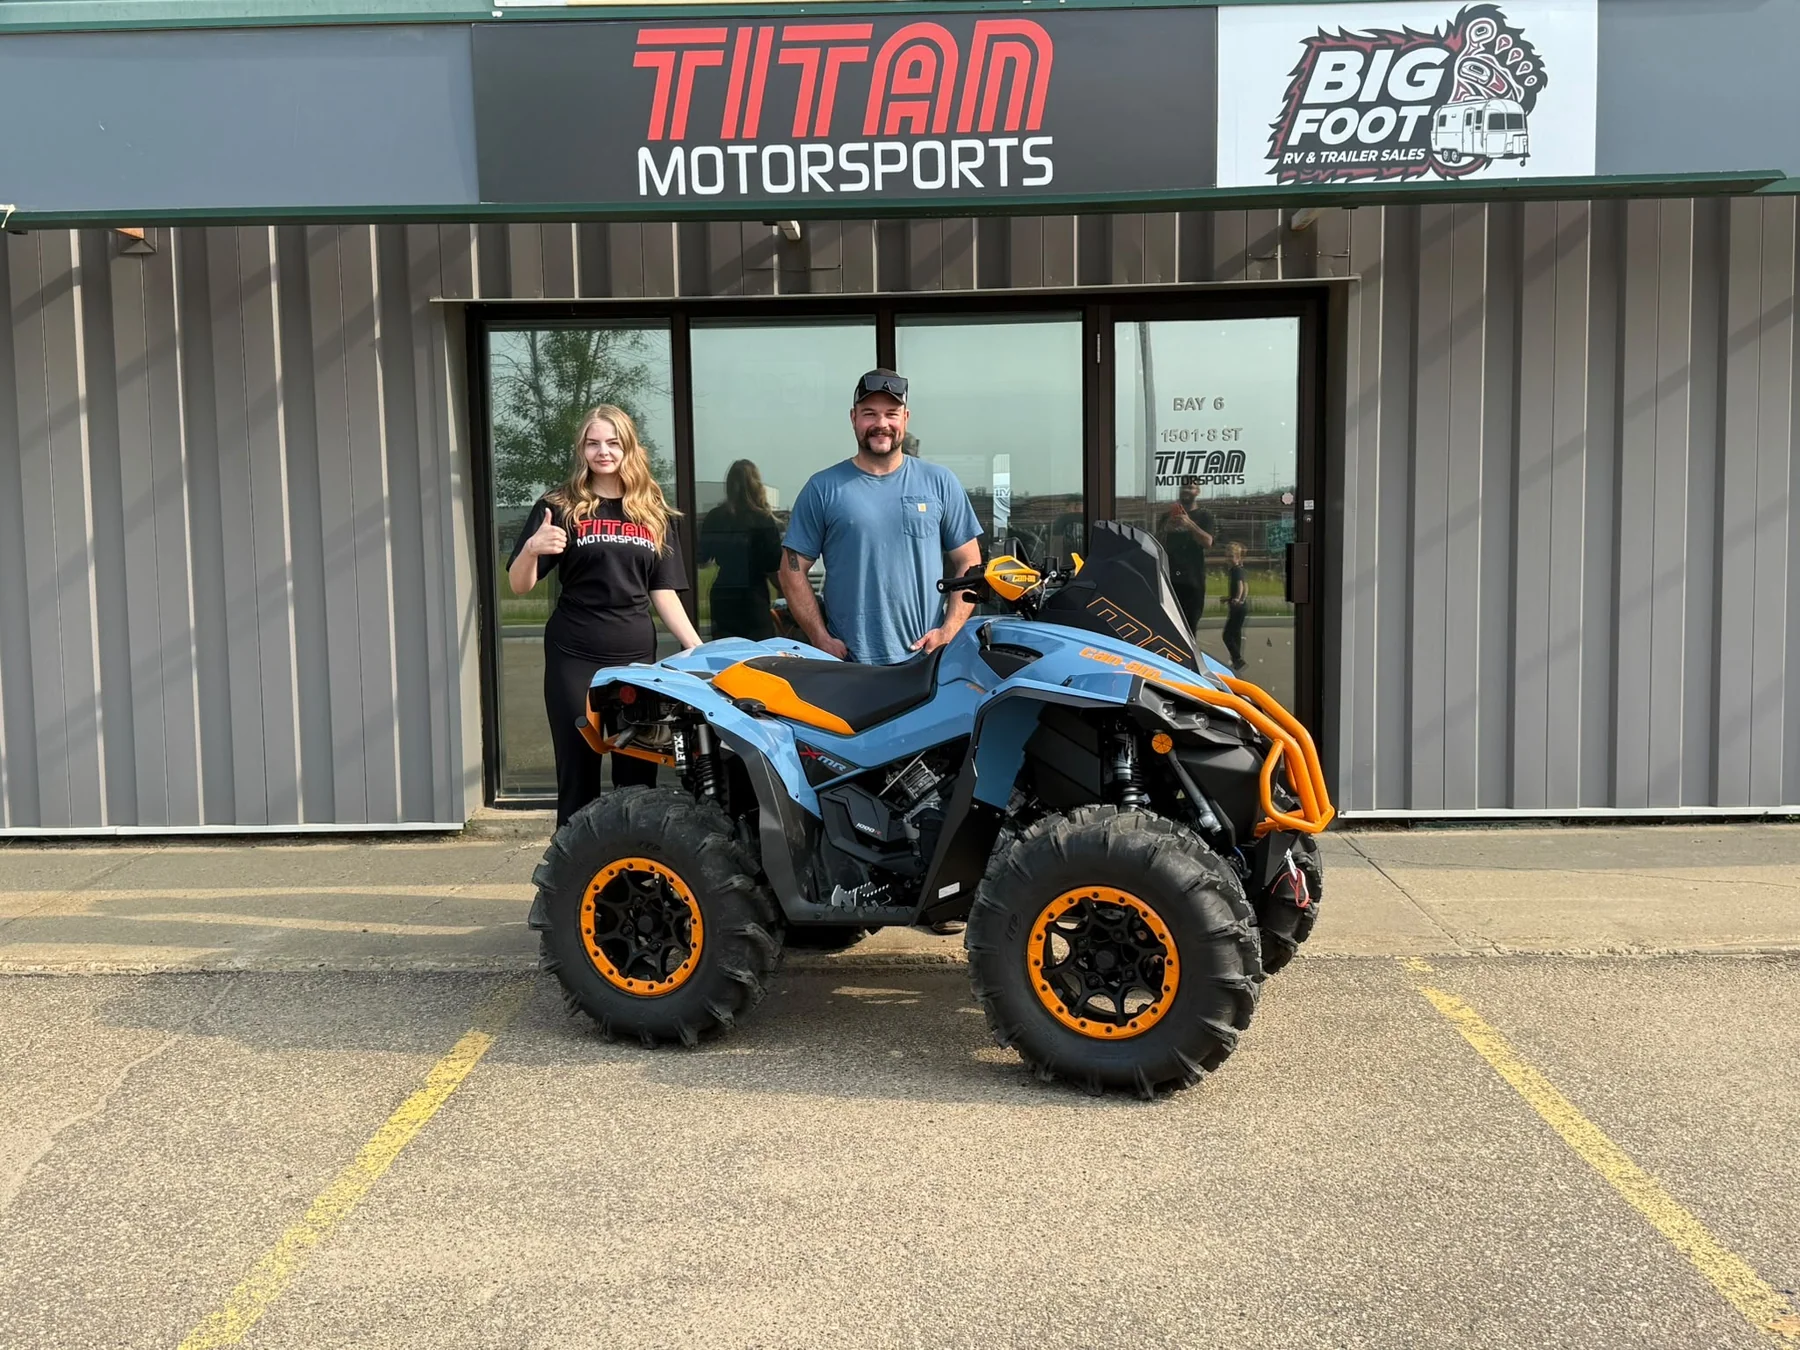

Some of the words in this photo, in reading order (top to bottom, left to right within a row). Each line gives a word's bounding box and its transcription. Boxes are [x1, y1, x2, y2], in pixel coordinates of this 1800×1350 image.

[632, 19, 1054, 141] TITAN
[1302, 47, 1451, 104] BIG
[1287, 105, 1433, 146] FOOT
[637, 136, 1054, 196] MOTORSPORTS
[1283, 152, 1305, 165] RV
[1306, 151, 1317, 164] &
[1320, 150, 1380, 163] TRAILER
[1381, 148, 1426, 161] SALES
[1173, 397, 1206, 411] BAY
[1213, 396, 1225, 411] 6
[1222, 427, 1243, 442] ST
[1154, 450, 1246, 475] TITAN
[1154, 474, 1245, 487] MOTORSPORTS
